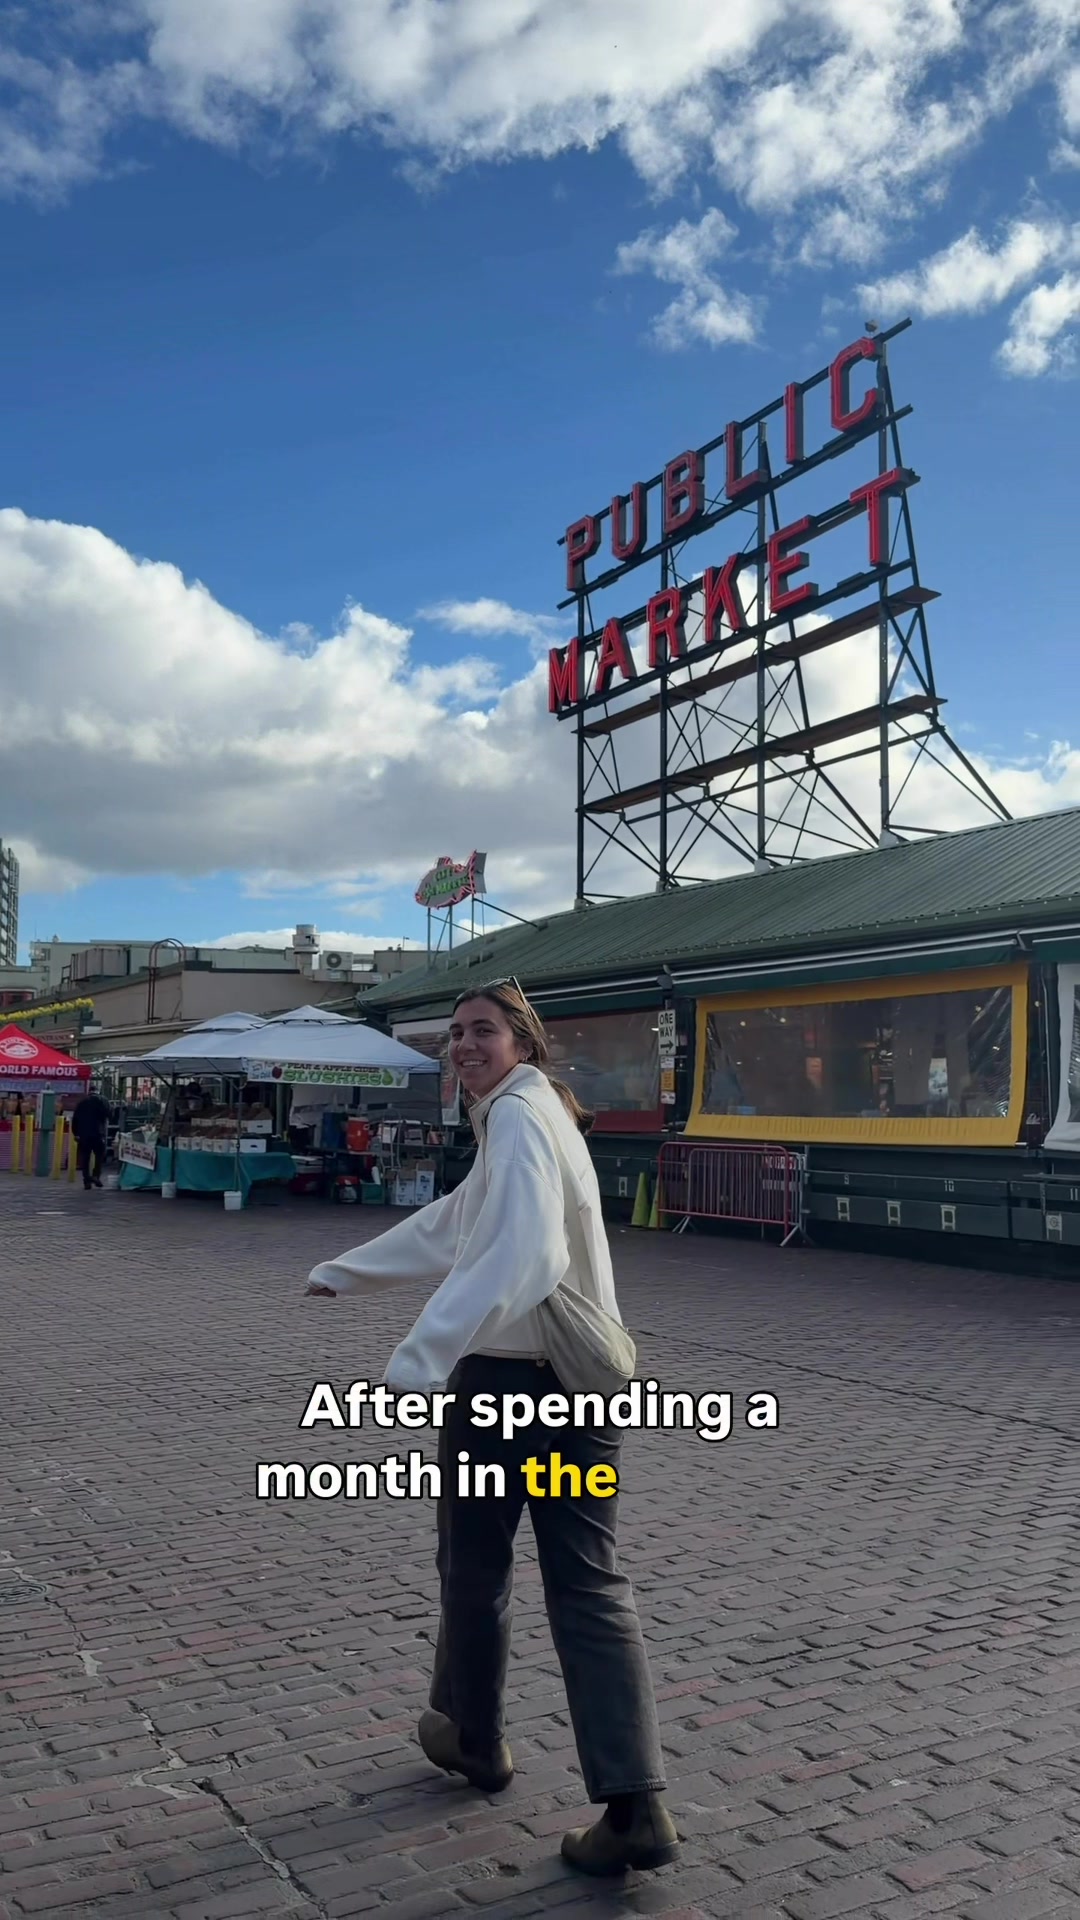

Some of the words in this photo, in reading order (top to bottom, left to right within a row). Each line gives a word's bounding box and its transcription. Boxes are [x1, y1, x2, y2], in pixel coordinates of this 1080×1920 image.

[566, 336, 883, 592] PUBLIC
[549, 467, 910, 713] MARKET
[660, 1012, 673, 1024] ONE
[660, 1026, 673, 1037] WAY
[0, 1064, 29, 1075] ORLD
[32, 1065, 78, 1076] FAMOUS
[283, 1069, 382, 1086] SLUSHIES
